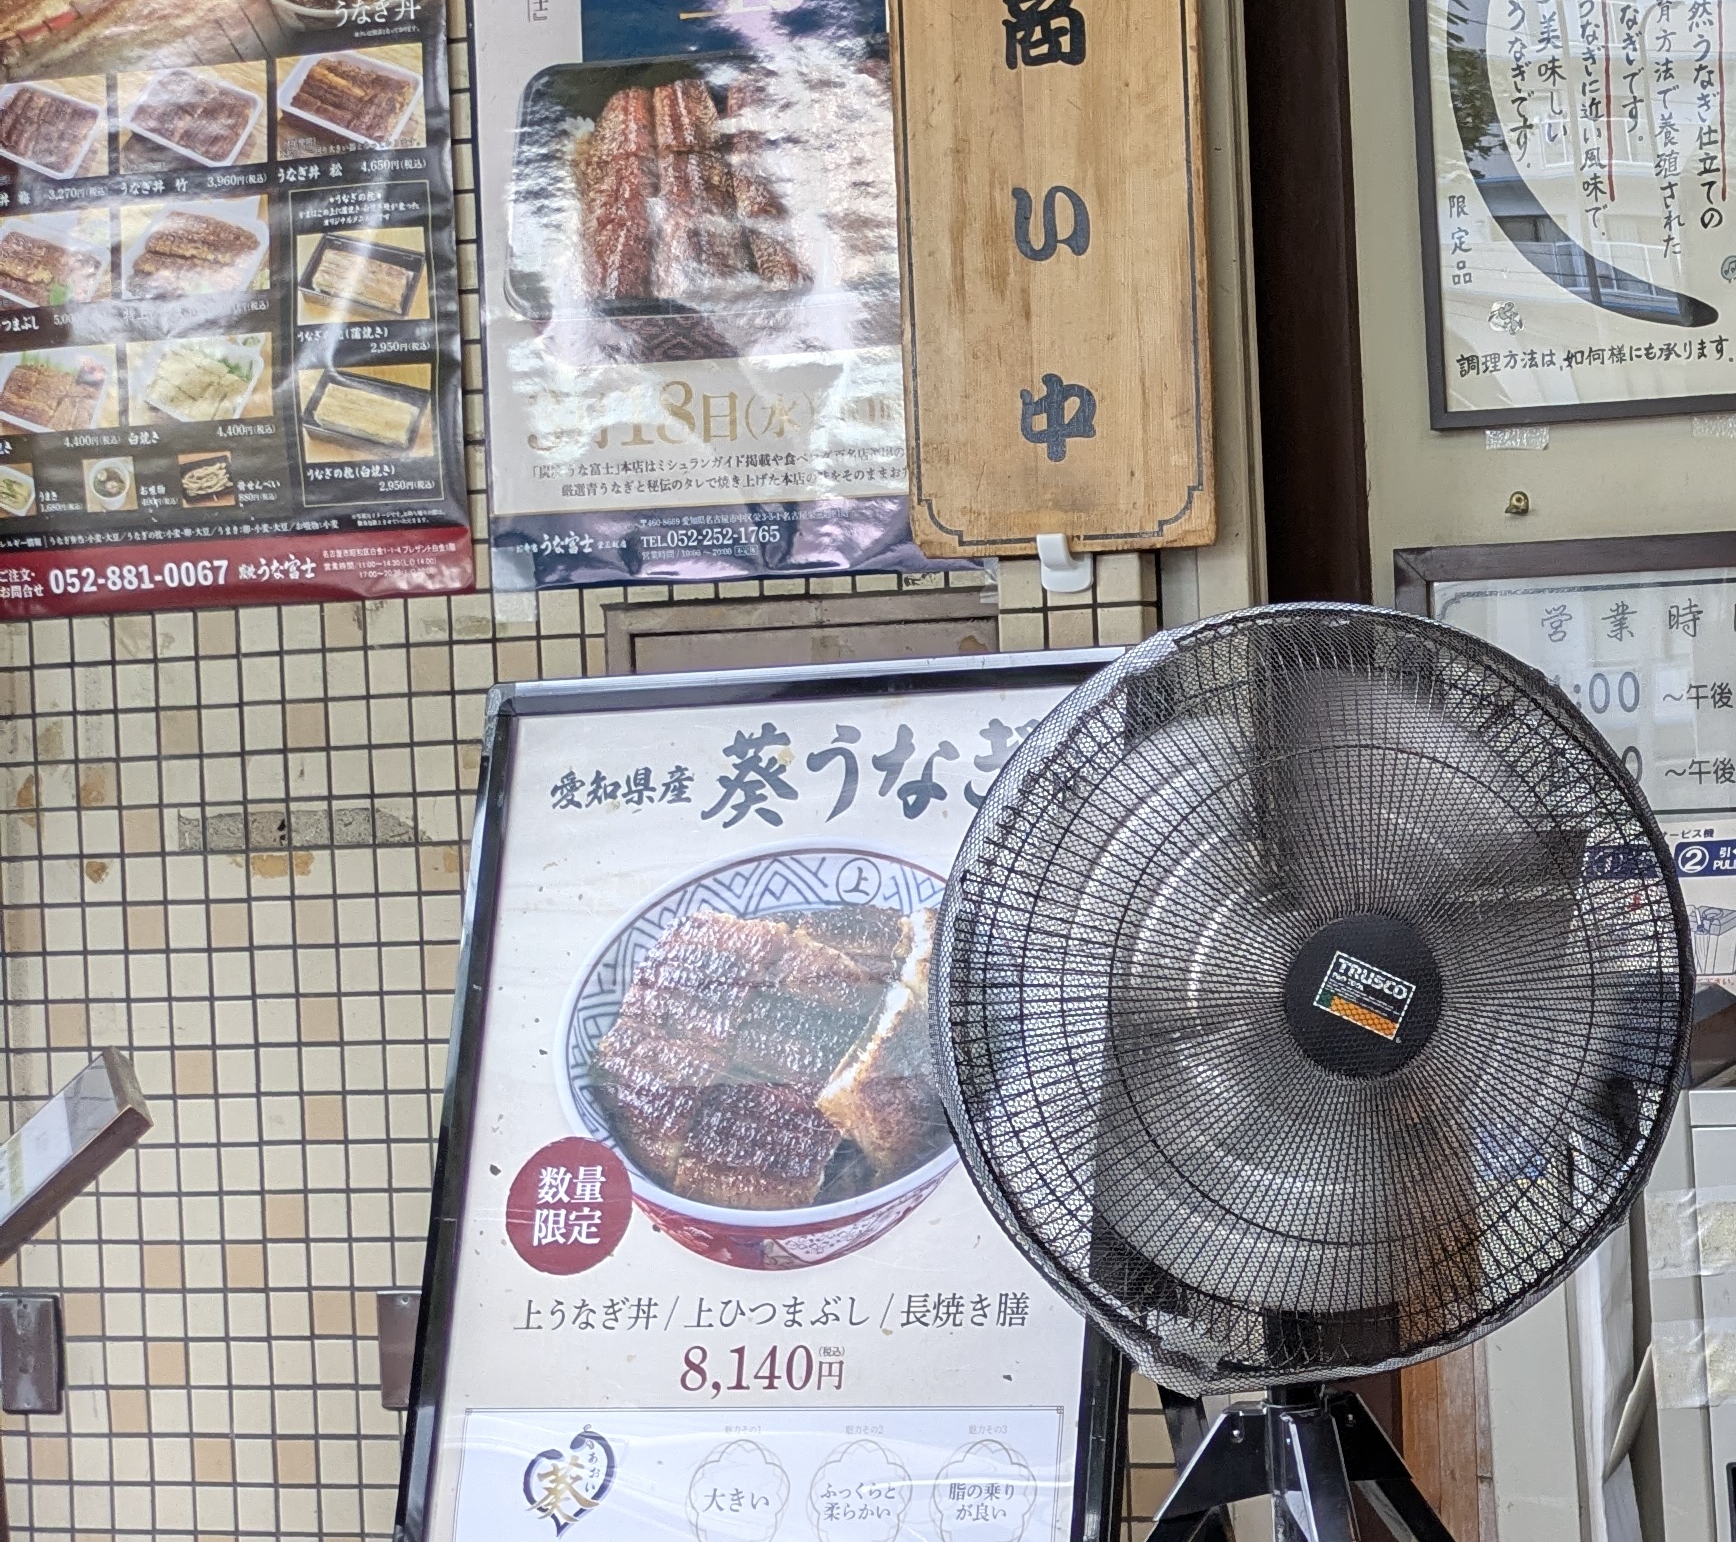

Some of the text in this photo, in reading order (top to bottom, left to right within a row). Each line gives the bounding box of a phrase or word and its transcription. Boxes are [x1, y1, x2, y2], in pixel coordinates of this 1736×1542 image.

[1507, 0, 1534, 169] うなぎです。
[277, 164, 321, 183] うなぎ丼
[329, 162, 343, 178] 松
[1448, 195, 1472, 286] 限定品
[0, 315, 39, 333] つまぶし
[297, 327, 389, 343] うなぎ(蒲焼き)
[540, 530, 594, 556] うな富士
[641, 525, 781, 548] TEL.052-252-1765
[49, 560, 229, 595] 052-881-0067
[257, 553, 317, 582] うな富士
[549, 766, 695, 810] 愛知県産
[1663, 828, 1714, 839] ービス機
[1338, 957, 1408, 1000] TRUSCO
[538, 1165, 606, 1206] 数量
[532, 1208, 604, 1248] 限定
[679, 1343, 845, 1400] 8,140円
[968, 1424, 1008, 1435] 魅力その3
[702, 1487, 771, 1513] 大きい
[820, 1482, 897, 1501] ふっくらと
[948, 1482, 1015, 1501] 脂の乗り
[823, 1504, 892, 1522] 柔らかい
[956, 1504, 1007, 1522] が良い
